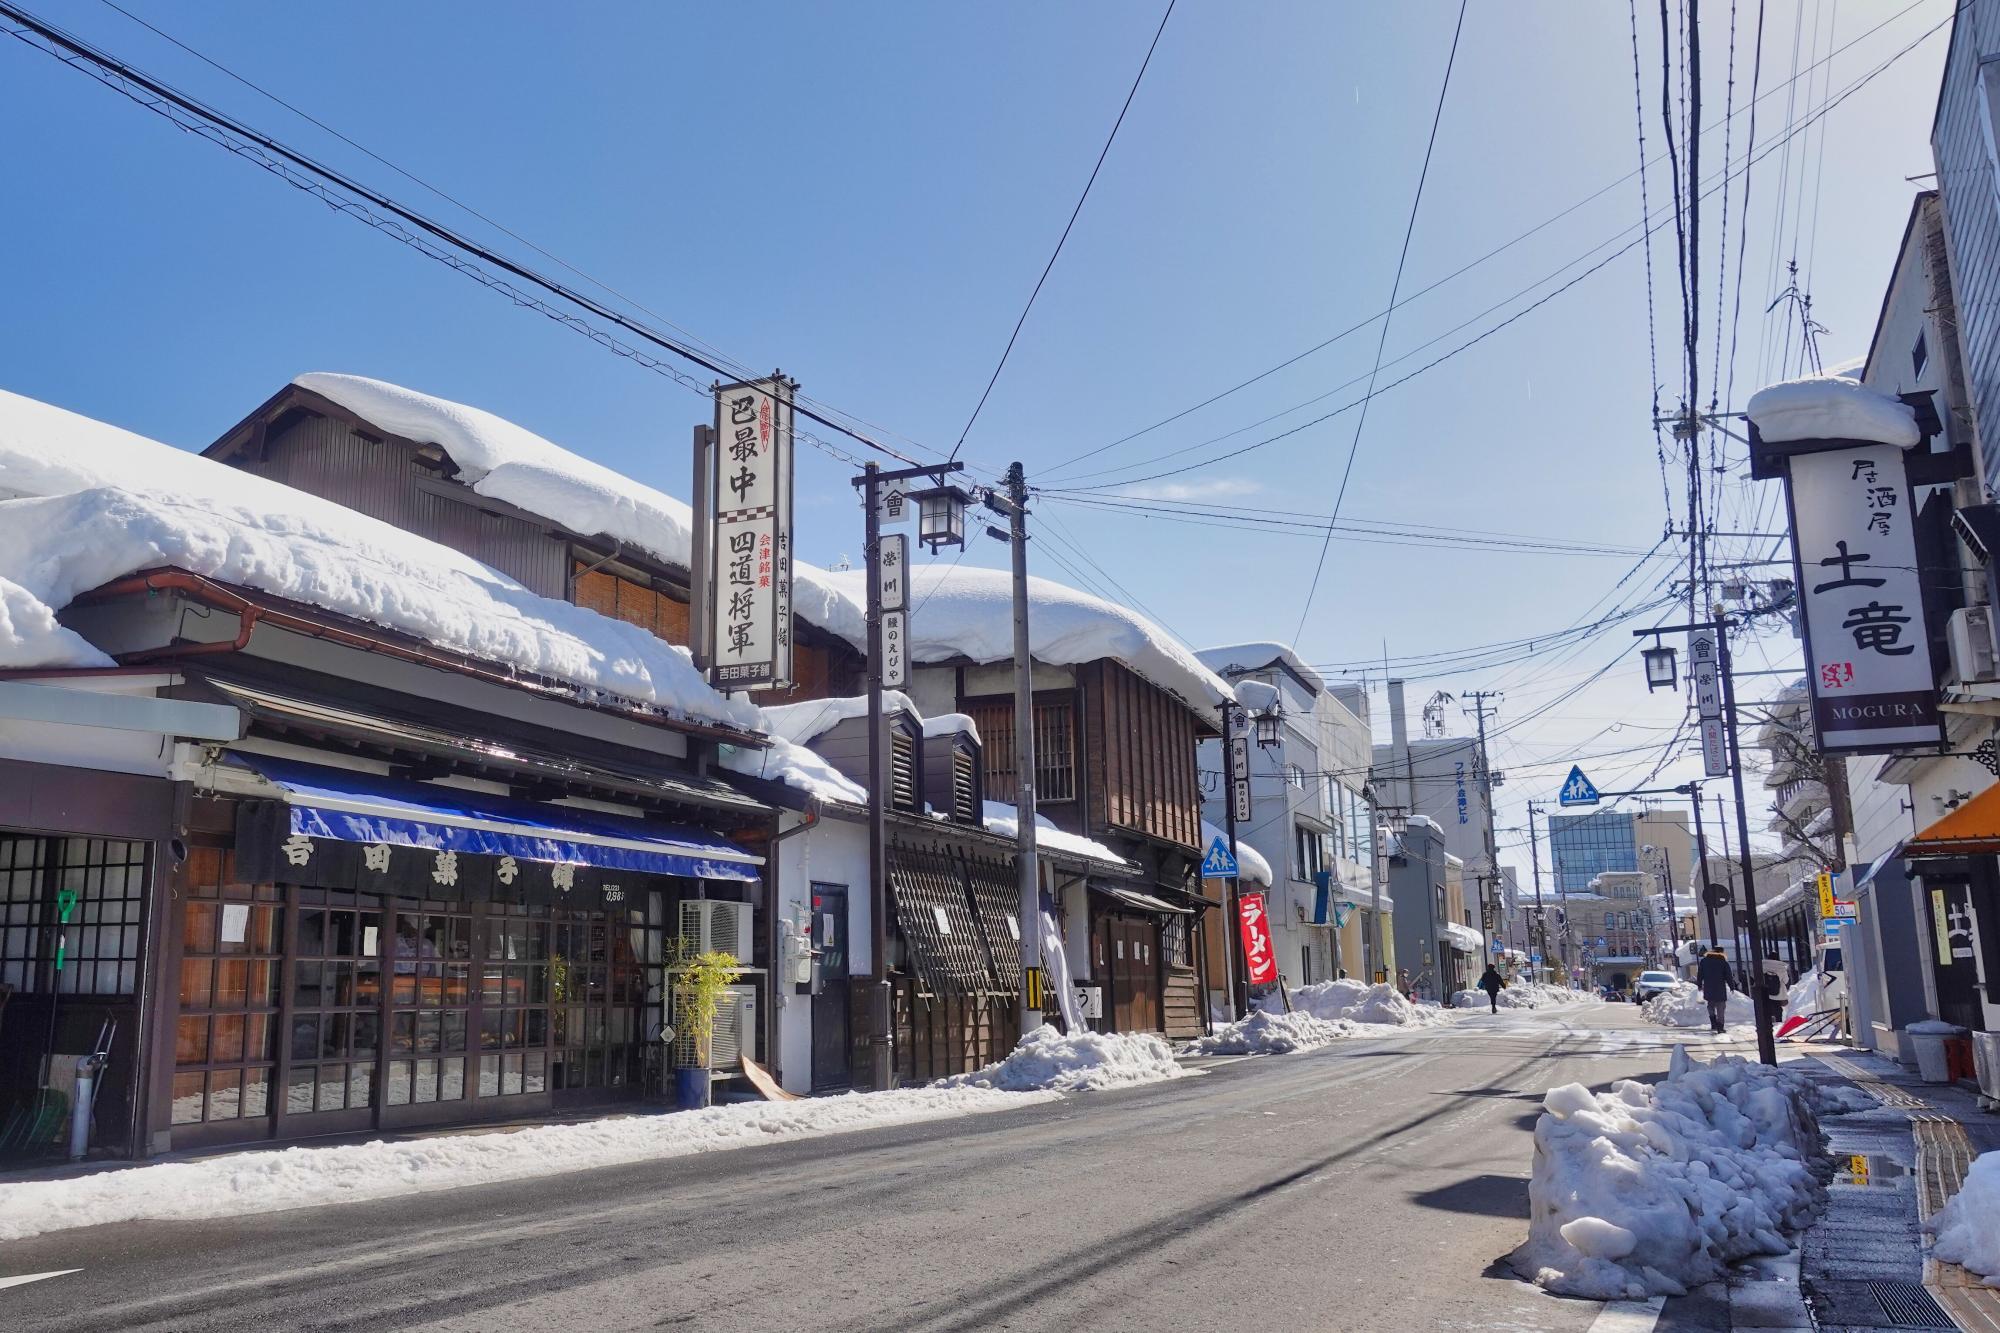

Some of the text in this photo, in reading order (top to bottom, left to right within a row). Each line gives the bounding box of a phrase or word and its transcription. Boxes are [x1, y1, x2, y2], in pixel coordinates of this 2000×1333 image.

[729, 395, 758, 503] 巴最中
[1852, 460, 1897, 536] 居酒屋
[727, 531, 756, 659] 四道将軍
[758, 534, 771, 588] 会津銘菓
[1813, 540, 1915, 656] 土竜
[719, 664, 770, 680] 吉田菓子舗
[1832, 702, 1924, 721] MOGURA
